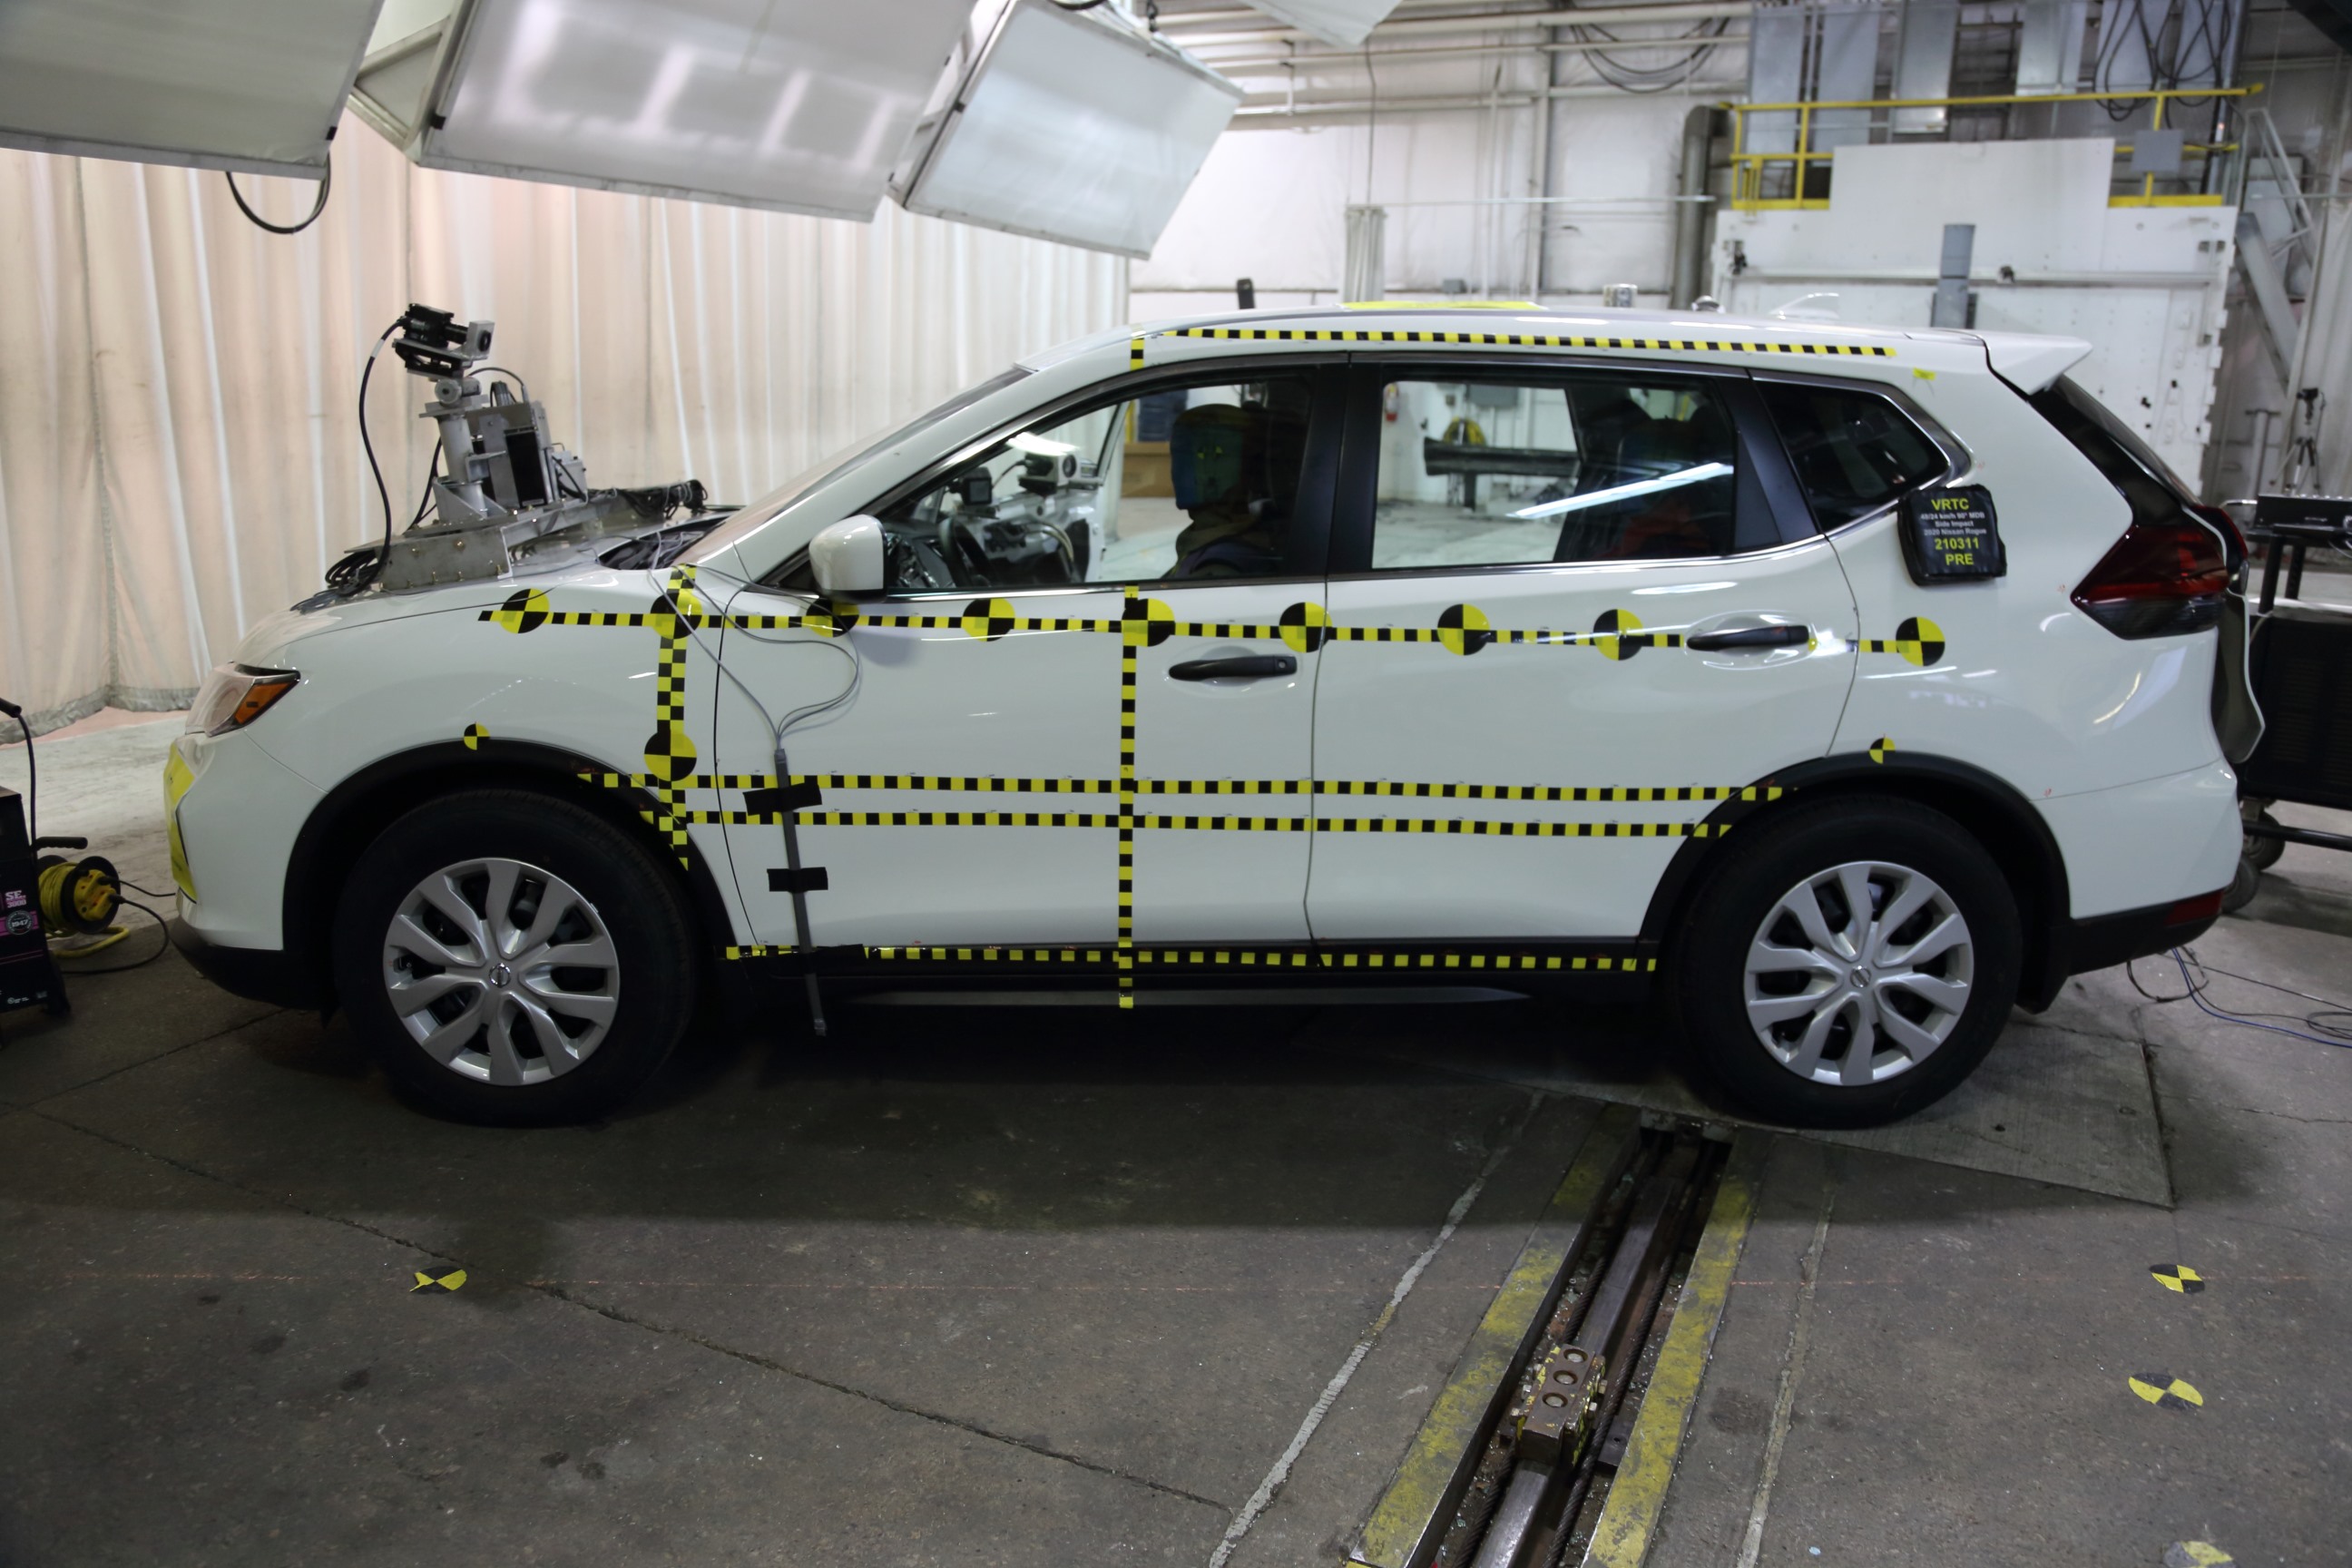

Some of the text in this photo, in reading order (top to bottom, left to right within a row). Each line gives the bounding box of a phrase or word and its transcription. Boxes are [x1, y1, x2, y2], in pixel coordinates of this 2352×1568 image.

[1931, 498, 1969, 511] VRTC
[1951, 520, 1975, 528] Impact
[1965, 527, 1987, 535] Rogue
[1935, 537, 1979, 550] 210311
[1945, 554, 1974, 565] PRE
[11, 919, 29, 927] 1947
